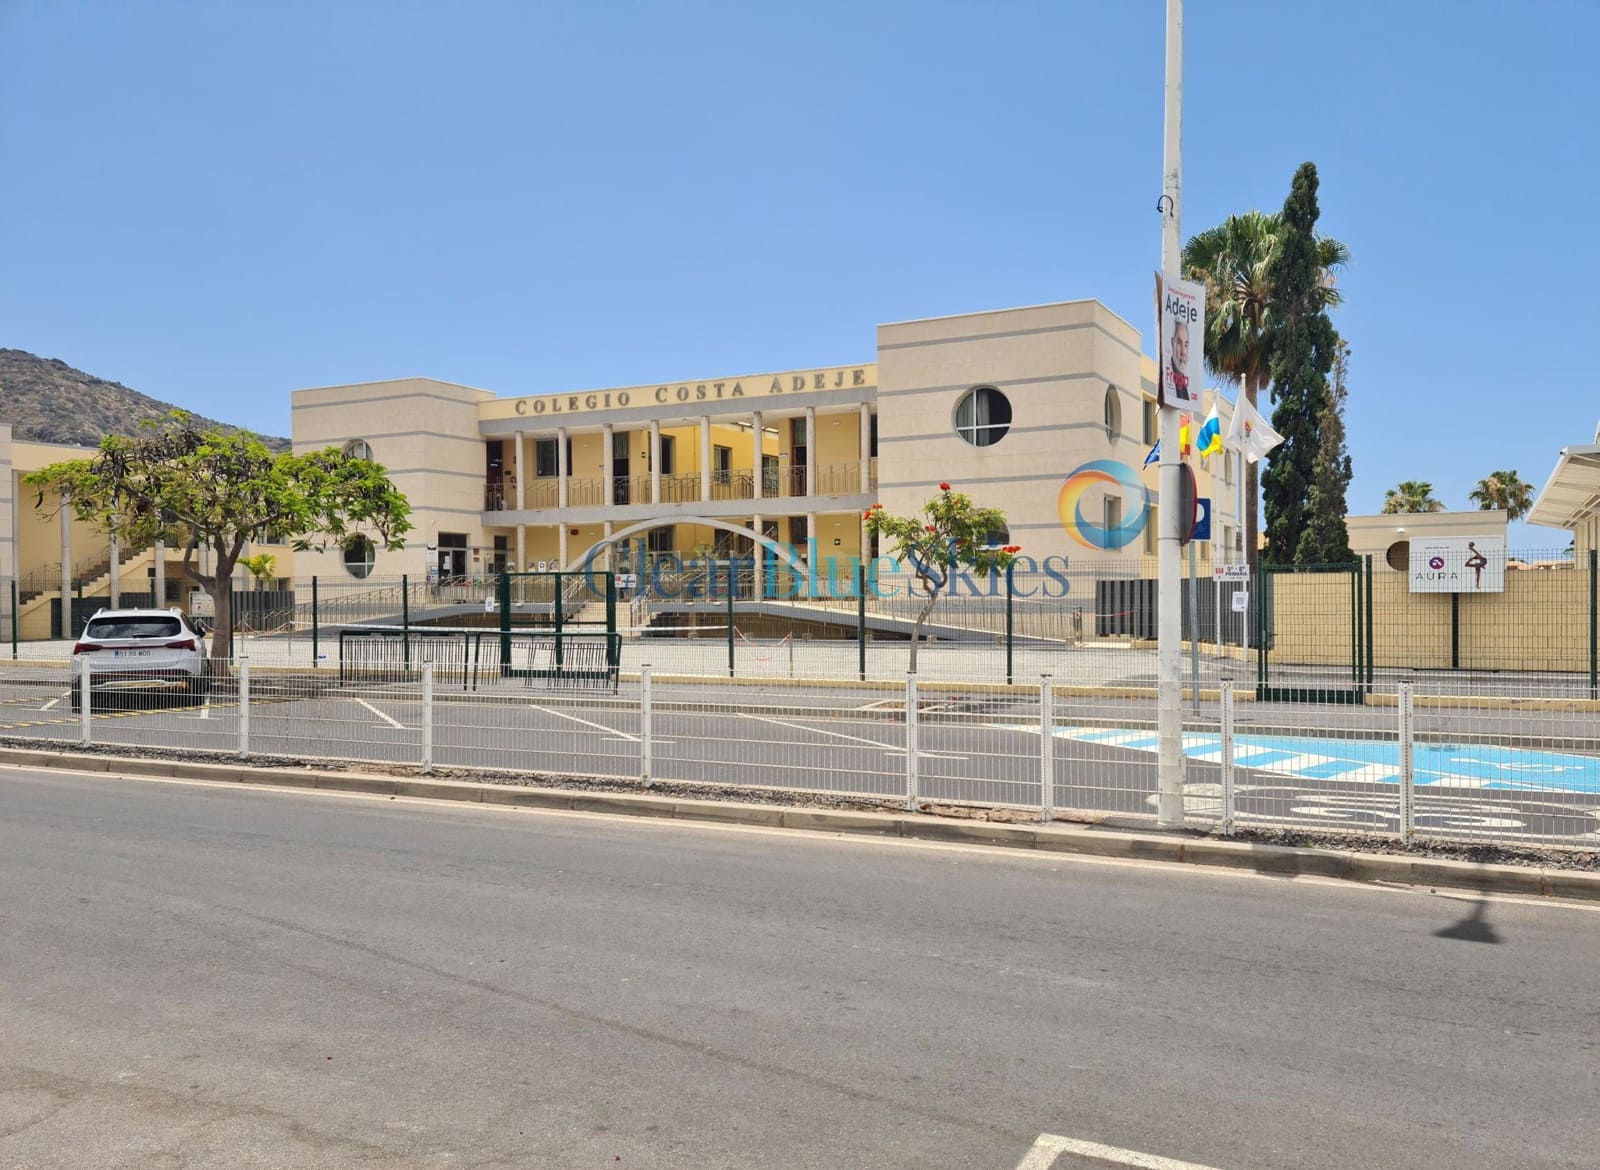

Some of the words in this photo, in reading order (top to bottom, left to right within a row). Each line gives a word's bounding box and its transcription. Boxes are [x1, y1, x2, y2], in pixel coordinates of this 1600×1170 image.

[1166, 294, 1197, 324] Adeje
[515, 392, 630, 415] COLEGIO
[655, 382, 744, 403] COSTA
[770, 370, 865, 393] ADEJE
[1415, 572, 1459, 581] AURA
